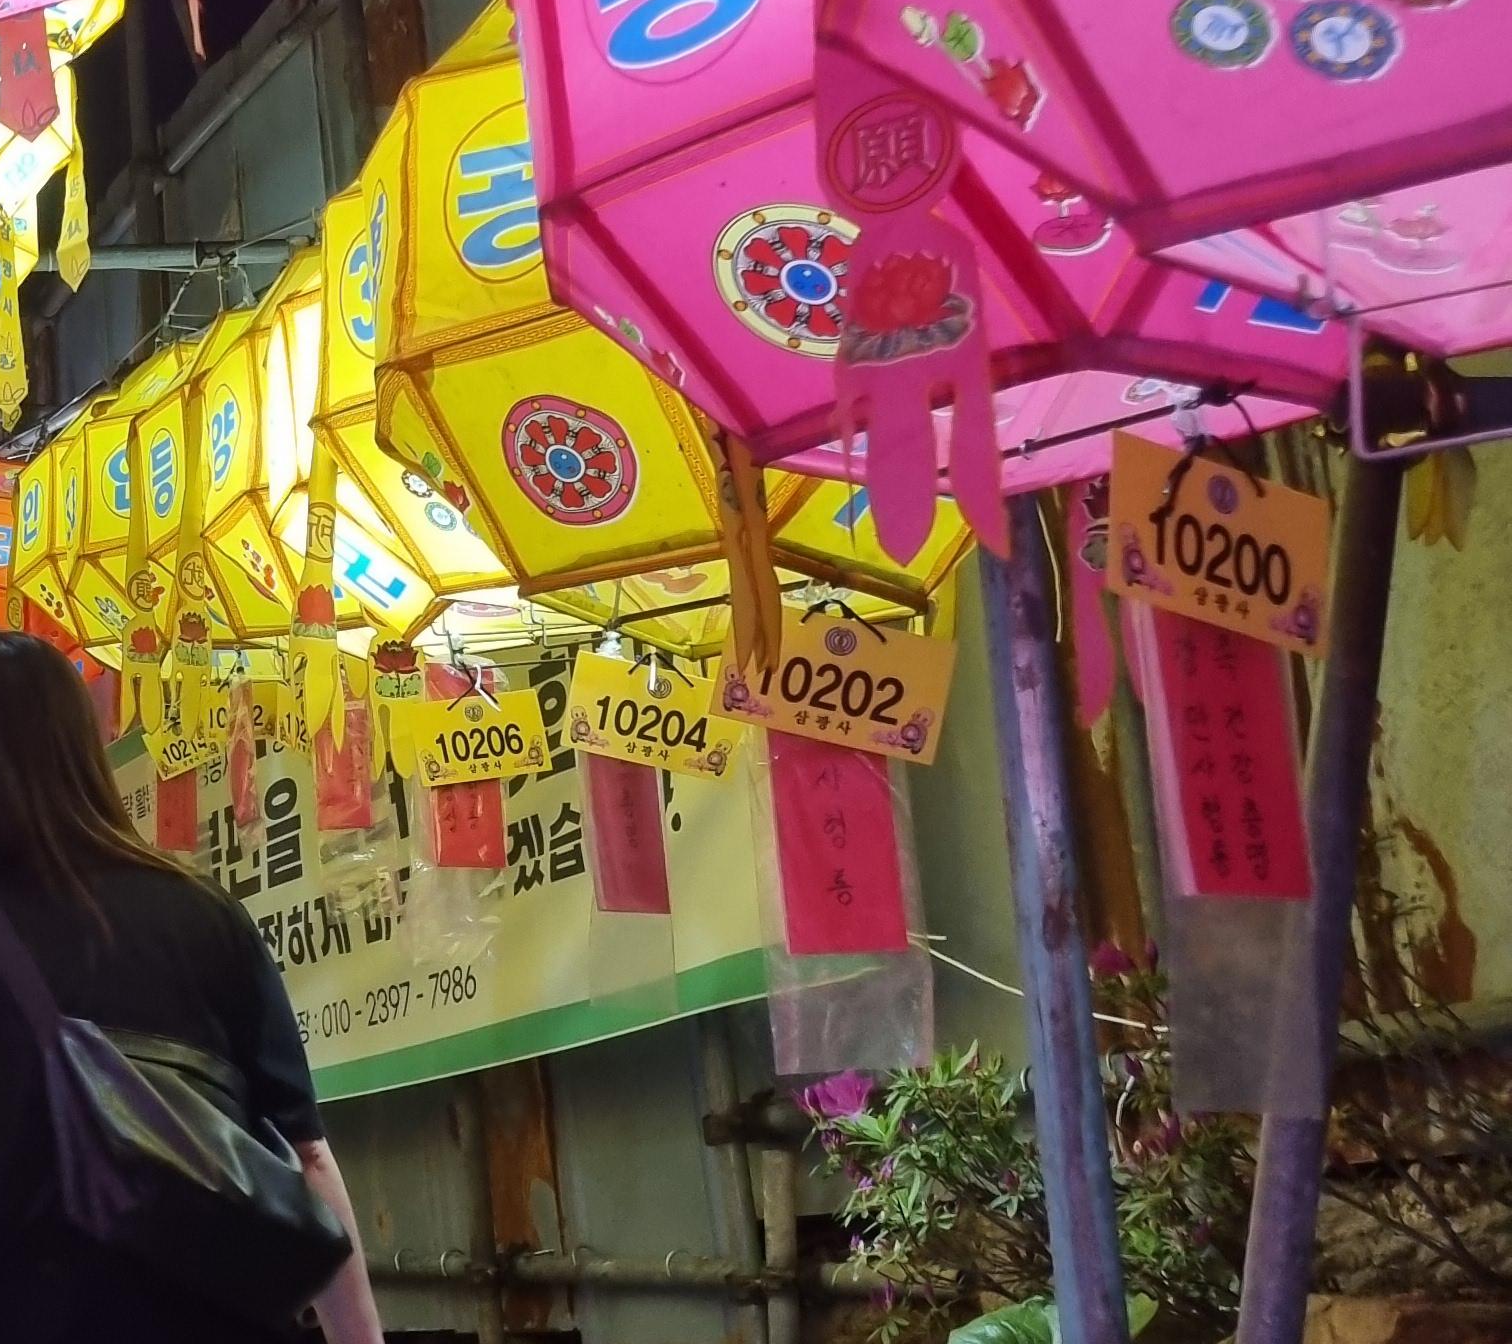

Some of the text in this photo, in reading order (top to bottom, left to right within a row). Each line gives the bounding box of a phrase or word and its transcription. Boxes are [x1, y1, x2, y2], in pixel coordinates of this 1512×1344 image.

[1150, 506, 1292, 607] 10200
[595, 694, 709, 754] 10204
[758, 655, 906, 727] 10202
[434, 722, 525, 765] 10206
